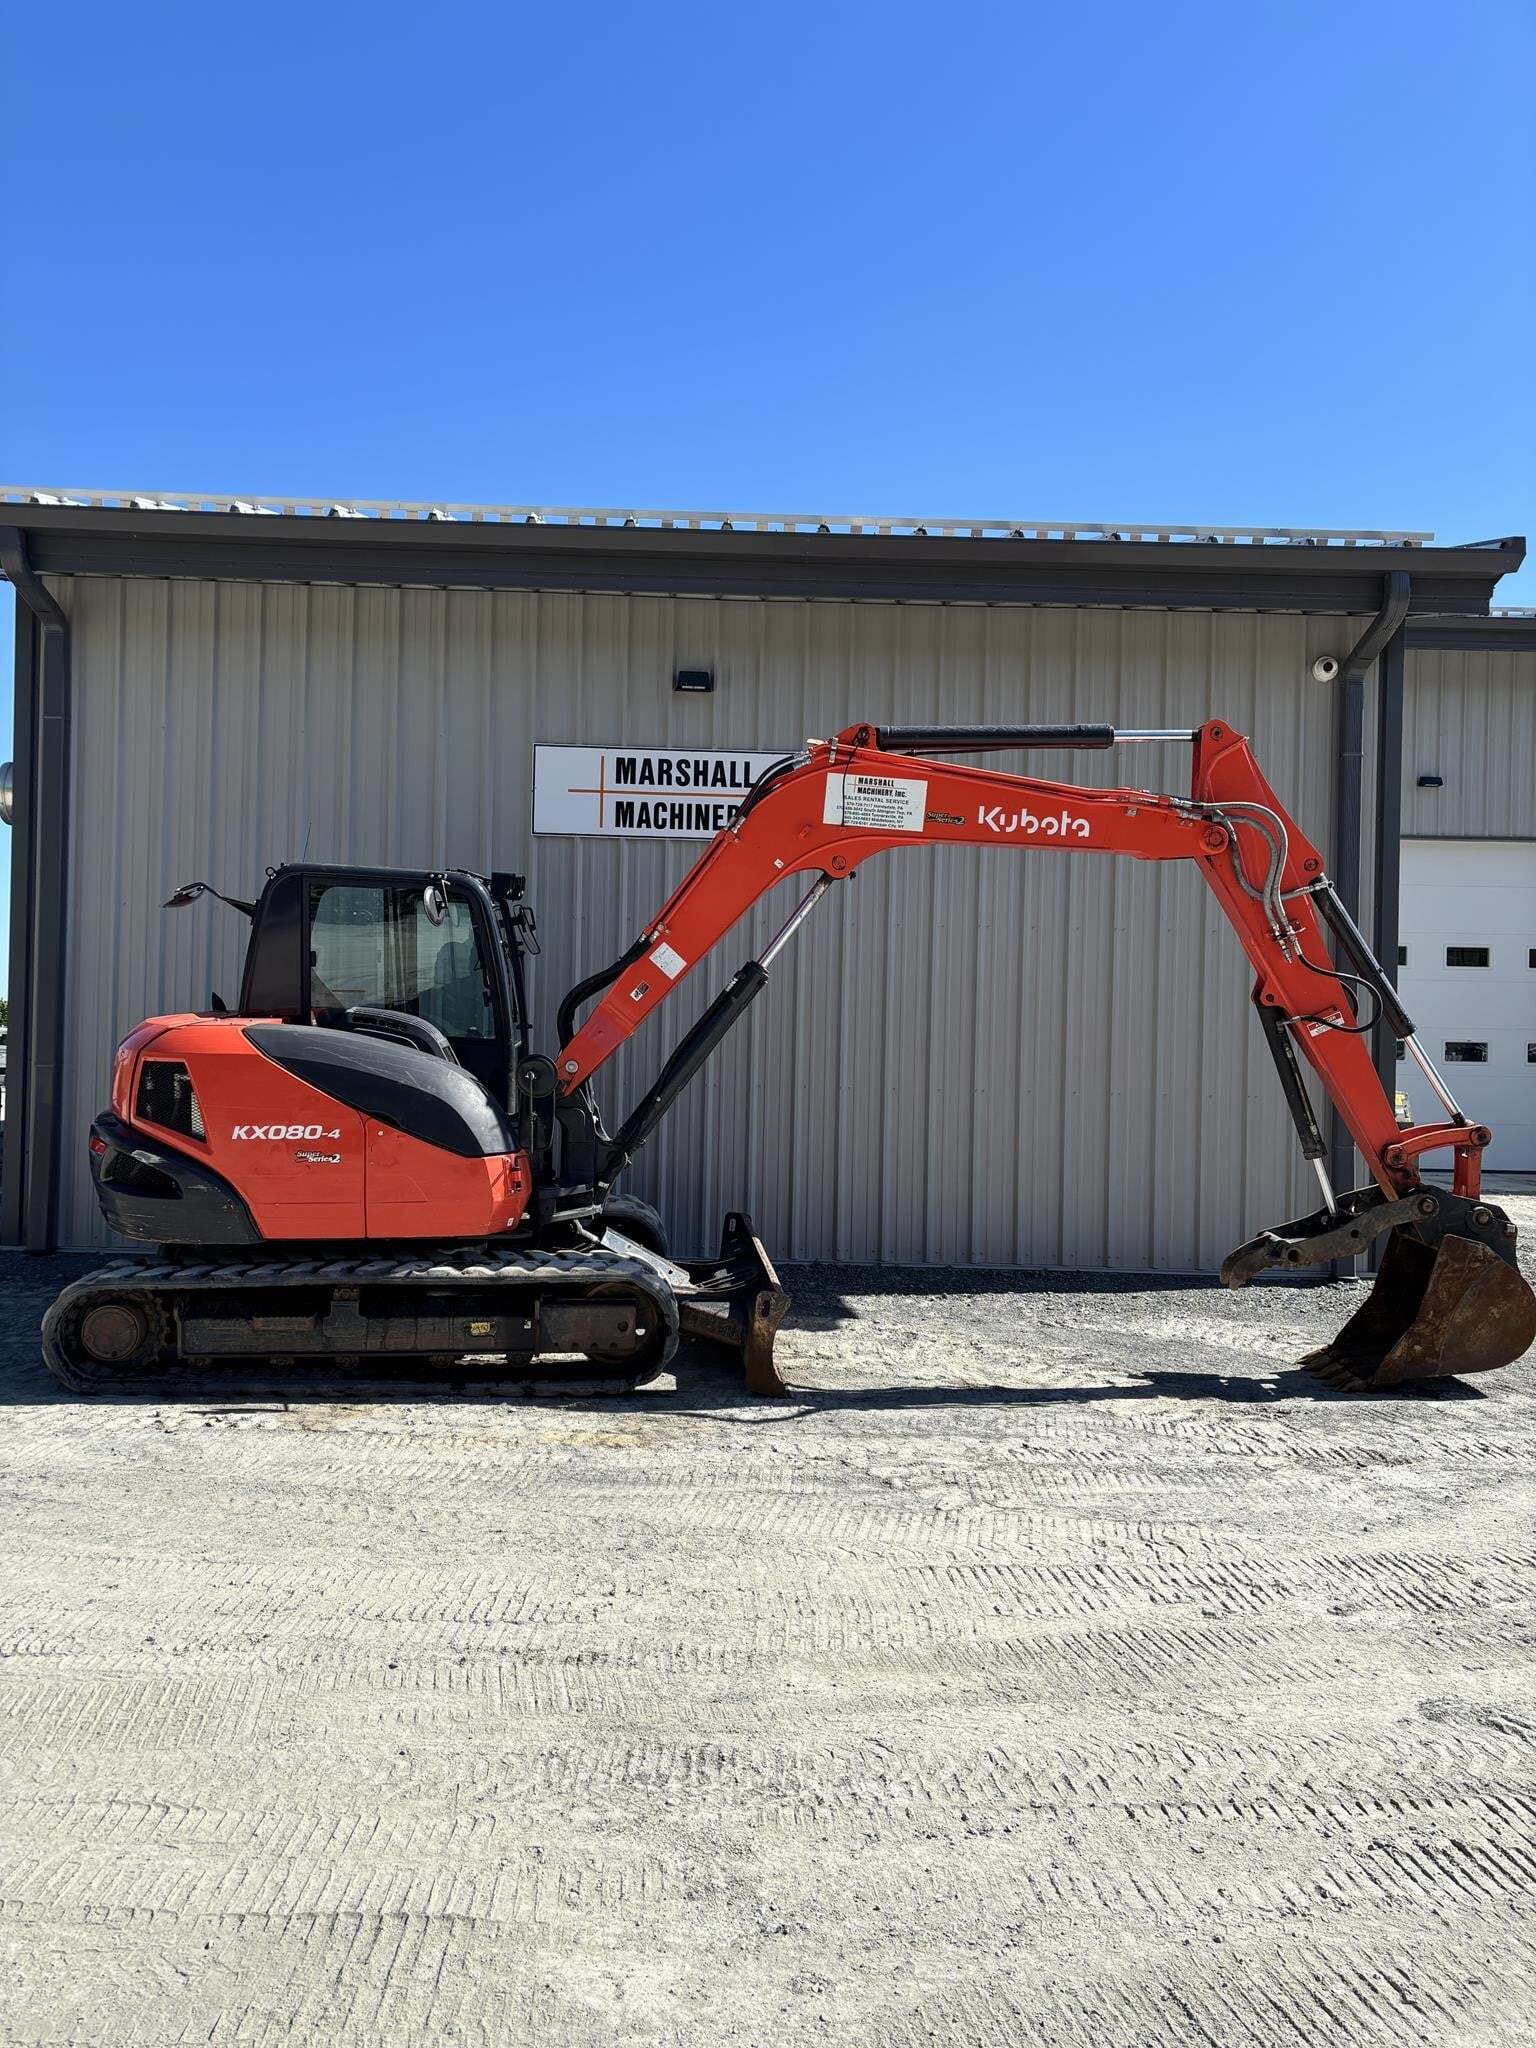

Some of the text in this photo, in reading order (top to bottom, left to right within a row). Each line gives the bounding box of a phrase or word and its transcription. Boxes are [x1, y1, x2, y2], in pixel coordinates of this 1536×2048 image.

[615, 757, 754, 789] MARSHALL
[858, 777, 894, 787] MARSHALL
[977, 805, 1091, 838] Kubota
[231, 1125, 341, 1140] KX080-4
[296, 1150, 321, 1158] Super
